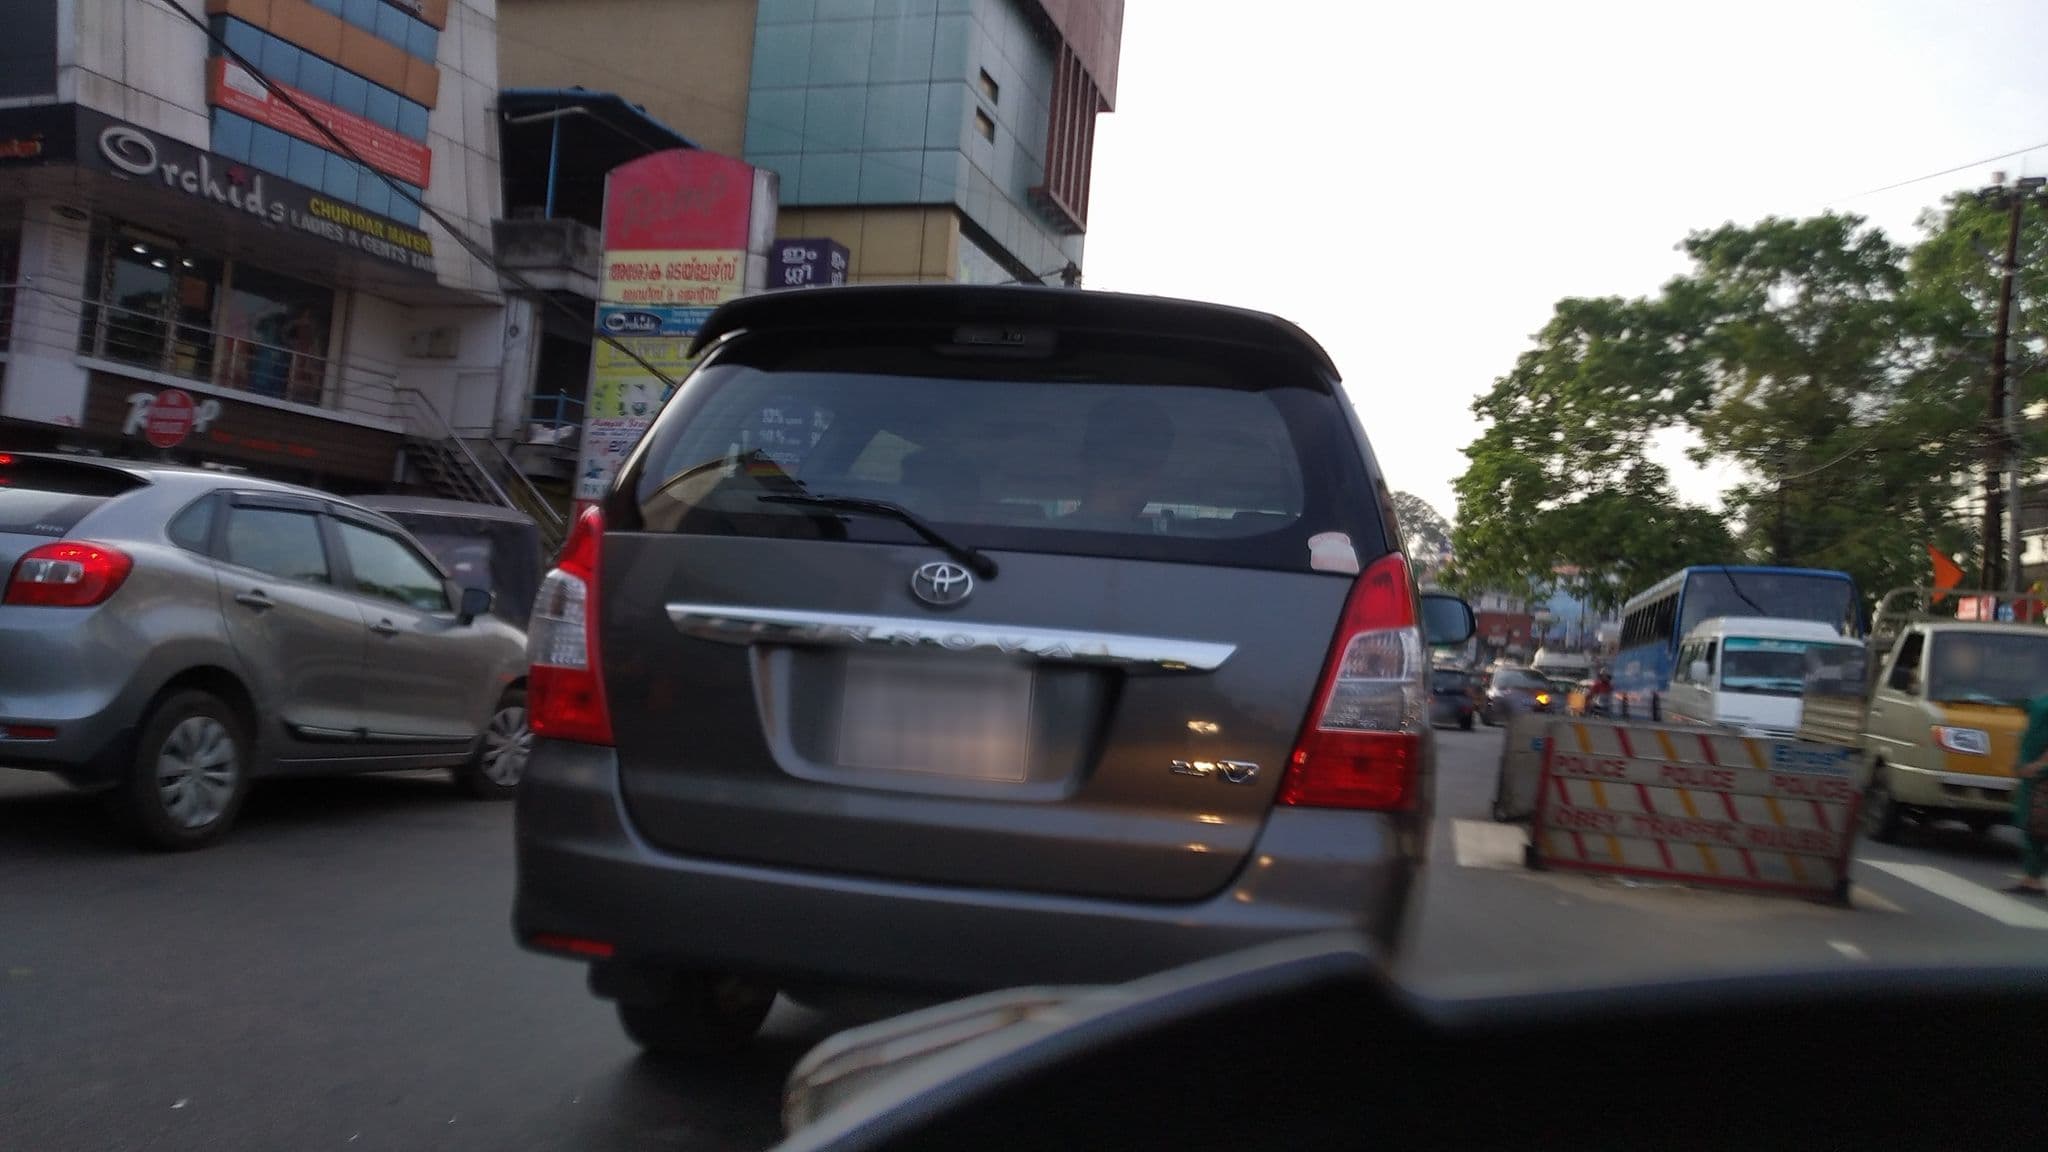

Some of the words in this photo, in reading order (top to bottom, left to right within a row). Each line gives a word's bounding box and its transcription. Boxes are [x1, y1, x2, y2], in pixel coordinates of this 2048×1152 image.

[100, 127, 286, 222] Orchids
[289, 208, 345, 243] LADIES
[360, 235, 408, 264] GENTS
[310, 198, 384, 238] CHURIDAR
[812, 622, 1074, 660] NNOVA
[1556, 754, 1627, 779] POLICE
[1659, 764, 1736, 790] POLICE
[1770, 774, 1850, 800] POLICE
